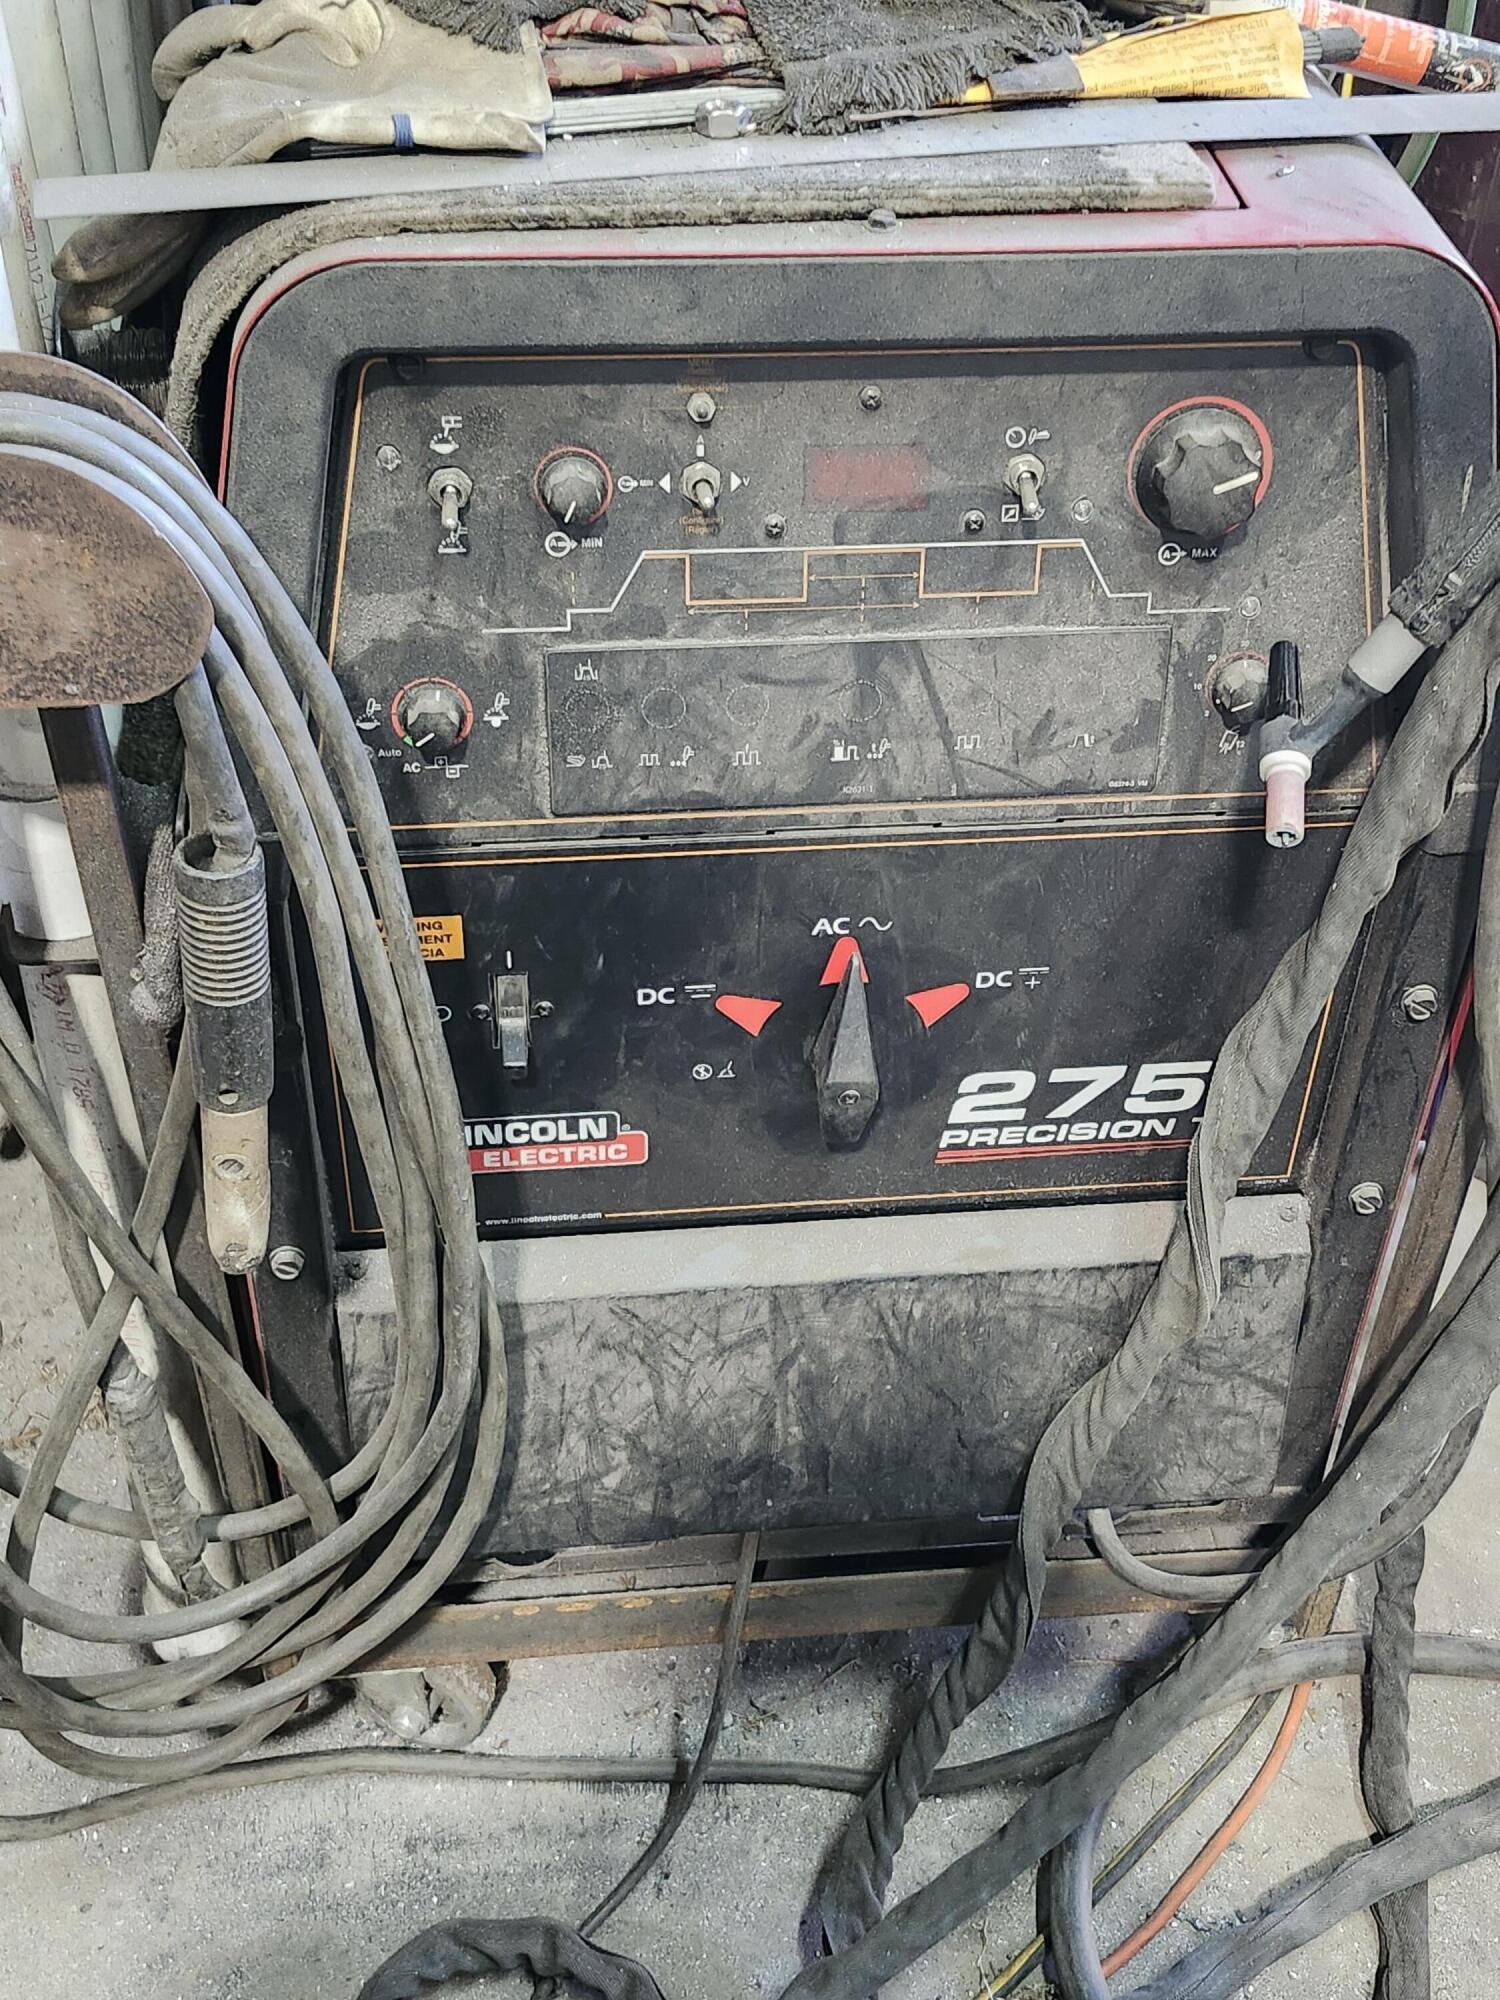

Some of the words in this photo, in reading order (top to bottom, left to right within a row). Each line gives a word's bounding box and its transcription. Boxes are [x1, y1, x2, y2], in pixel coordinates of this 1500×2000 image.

[581, 537, 603, 549] MIN
[1191, 547, 1218, 559] MAX
[1193, 683, 1202, 691] 10
[377, 748, 402, 758] Auto
[403, 762, 421, 774] AC
[811, 917, 851, 936] AC
[975, 970, 1013, 989] DC
[636, 986, 676, 1006] DC
[947, 1060, 1213, 1125] 275
[464, 1117, 607, 1147] INCOLN
[939, 1117, 1177, 1149] PRECISION
[483, 1143, 628, 1168] ELECTRIC
